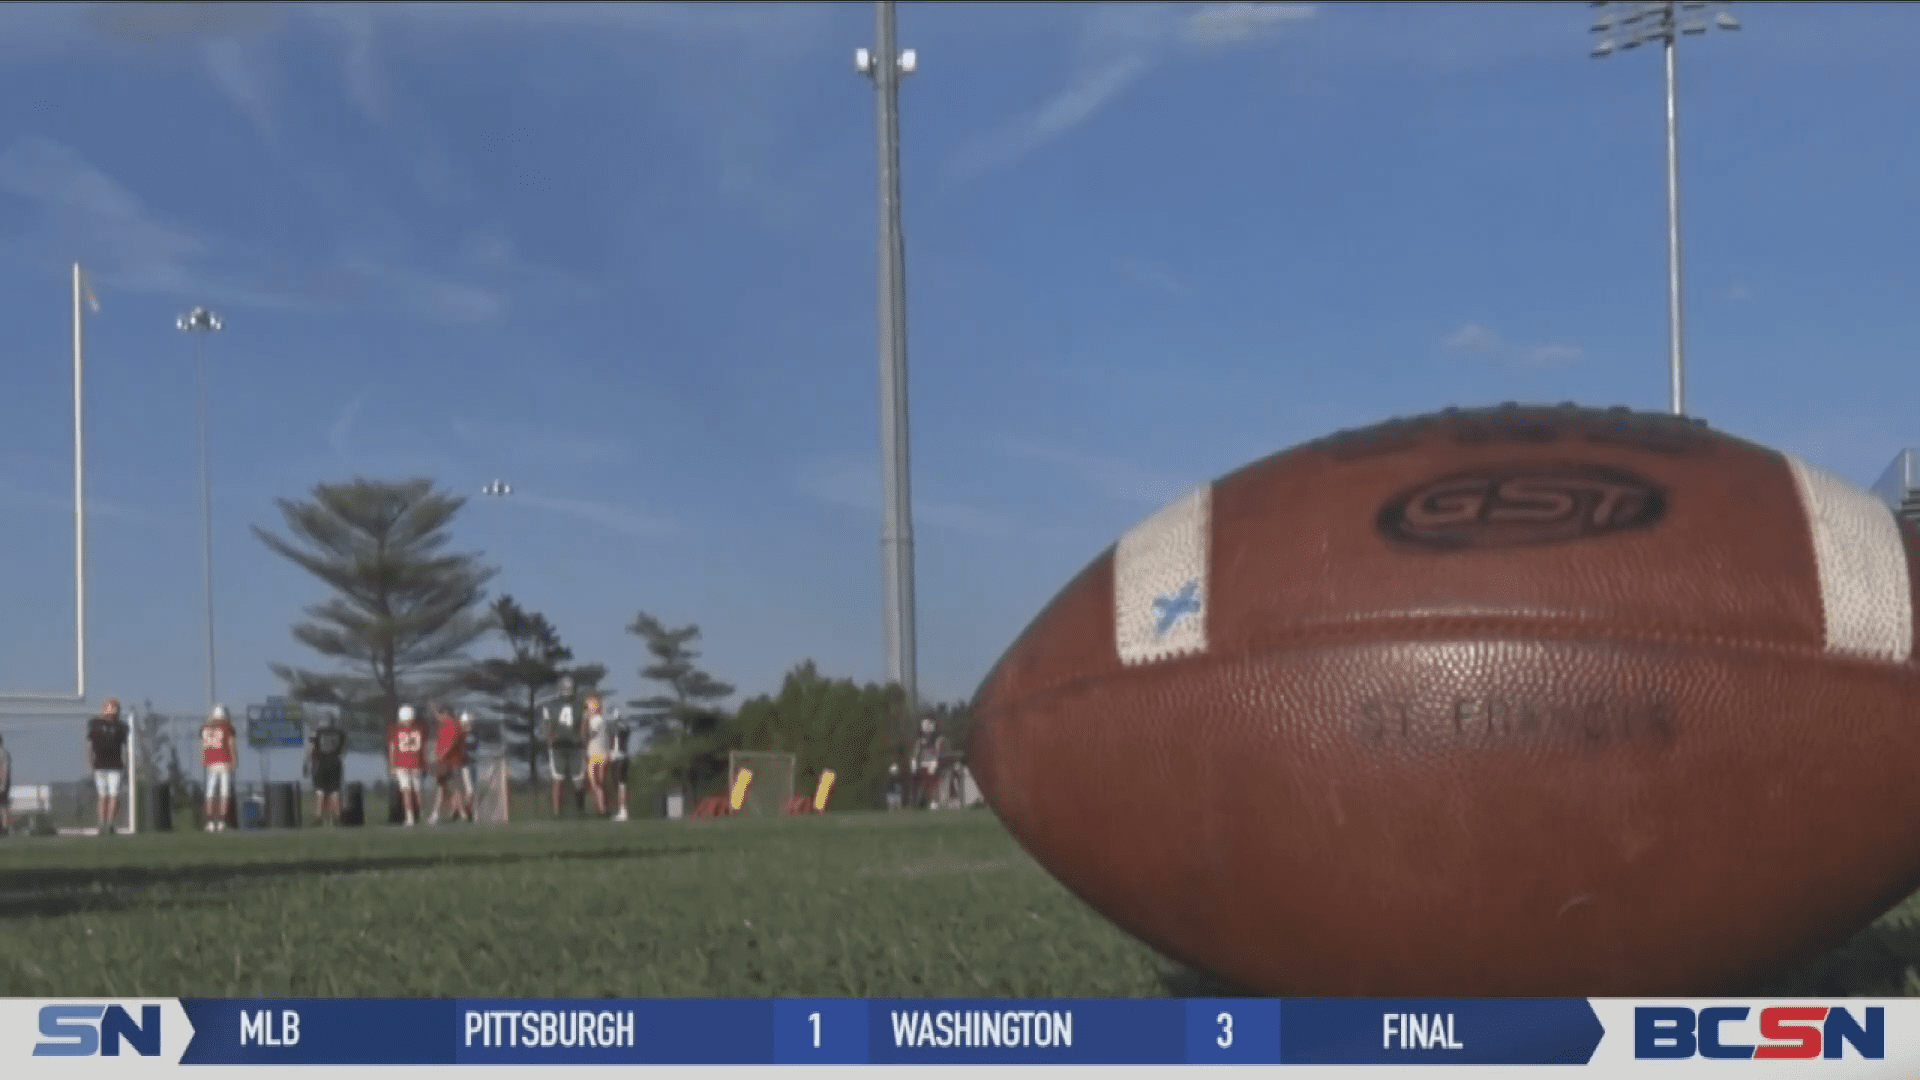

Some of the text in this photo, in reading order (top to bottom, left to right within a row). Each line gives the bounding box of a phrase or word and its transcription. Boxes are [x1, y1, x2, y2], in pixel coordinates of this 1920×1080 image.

[1404, 477, 1650, 527] GST
[560, 706, 574, 727] 4
[398, 731, 421, 752] 23
